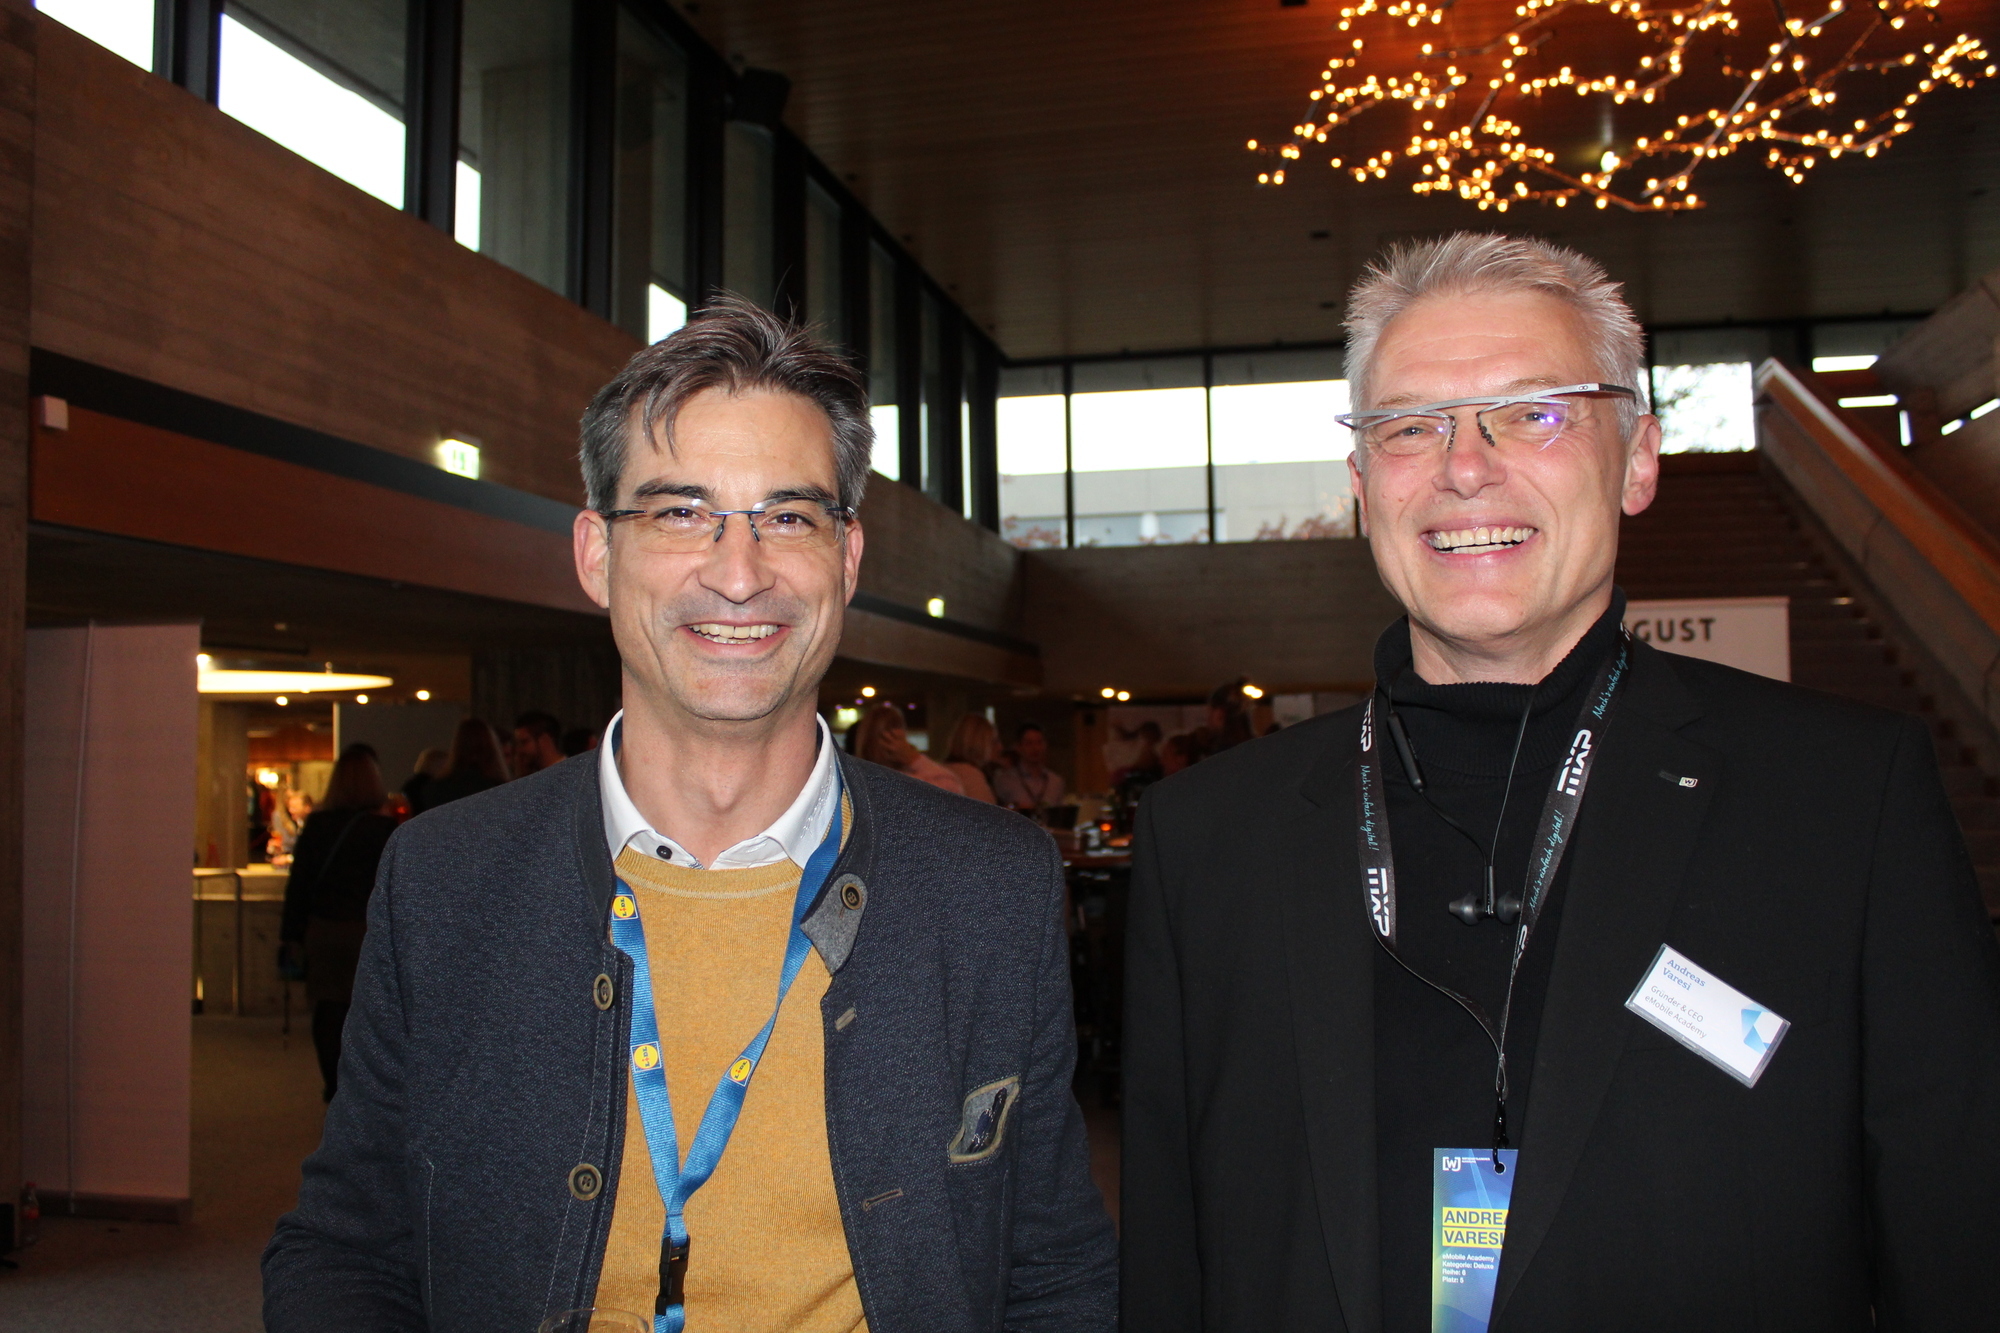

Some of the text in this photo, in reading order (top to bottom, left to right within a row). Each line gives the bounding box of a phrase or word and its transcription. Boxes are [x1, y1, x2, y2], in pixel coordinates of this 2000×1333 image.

[1623, 617, 1716, 642] GUST
[1663, 967, 1692, 991] Varesi
[1667, 960, 1706, 987] Andreas
[1651, 985, 1704, 1022] Gründer & CEO
[1644, 995, 1707, 1039] eMobile Academy
[1444, 1230, 1504, 1245] VARESI
[1442, 1252, 1495, 1262] eMobile Academy
[1473, 1262, 1495, 1270] Deluxe
[1442, 1268, 1461, 1276] Reihe:
